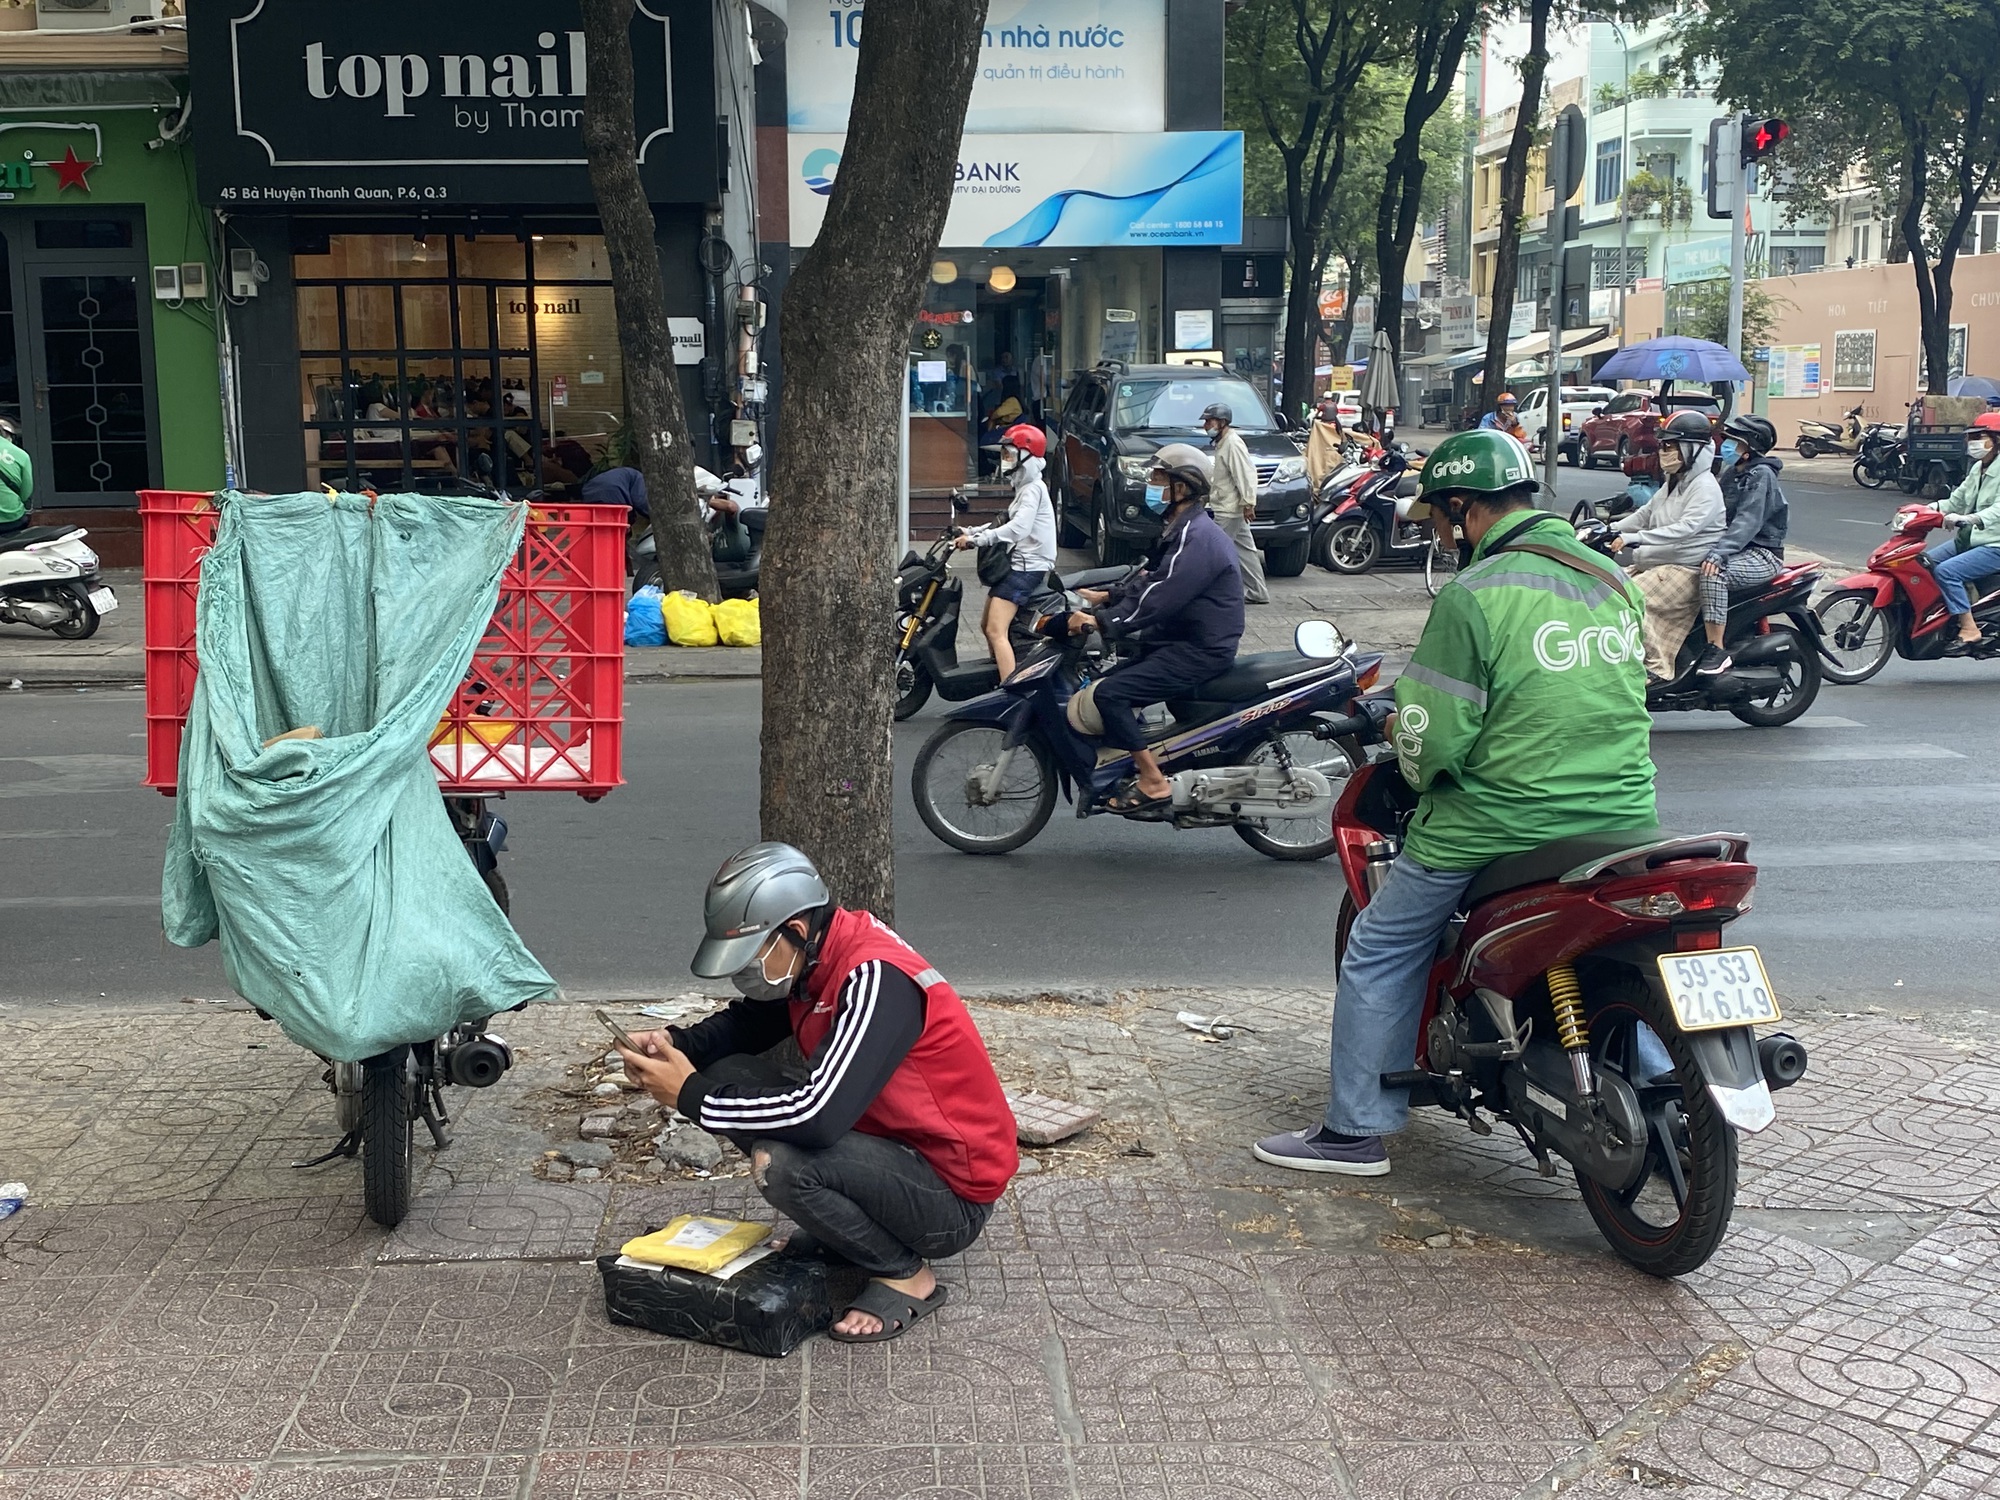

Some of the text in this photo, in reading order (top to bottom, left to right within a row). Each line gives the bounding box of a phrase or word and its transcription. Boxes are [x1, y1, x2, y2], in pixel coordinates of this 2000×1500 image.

[1001, 25, 1050, 48] nhà
[1059, 25, 1124, 48] nước
[302, 31, 587, 117] top nail
[984, 63, 1025, 82] quản
[1029, 64, 1043, 82] trị
[1048, 63, 1081, 80] điều
[1085, 63, 1125, 80] hành
[455, 104, 489, 134] by
[220, 186, 447, 201] 45 Bà Huyện Thanh Quan, P.6, Q.3
[971, 186, 987, 195] ĐẠI
[1129, 230, 1204, 238] www.oceanbank.vn
[1174, 221, 1192, 229] 1800
[1685, 247, 1721, 266] THE VILLA
[544, 299, 581, 314] nail
[679, 333, 702, 343] nail
[651, 431, 673, 450] 19
[1432, 455, 1476, 479] Grab
[1533, 610, 1646, 672] Grab
[1192, 745, 1221, 758] YAMAHA
[1675, 955, 1750, 988] 59-S3
